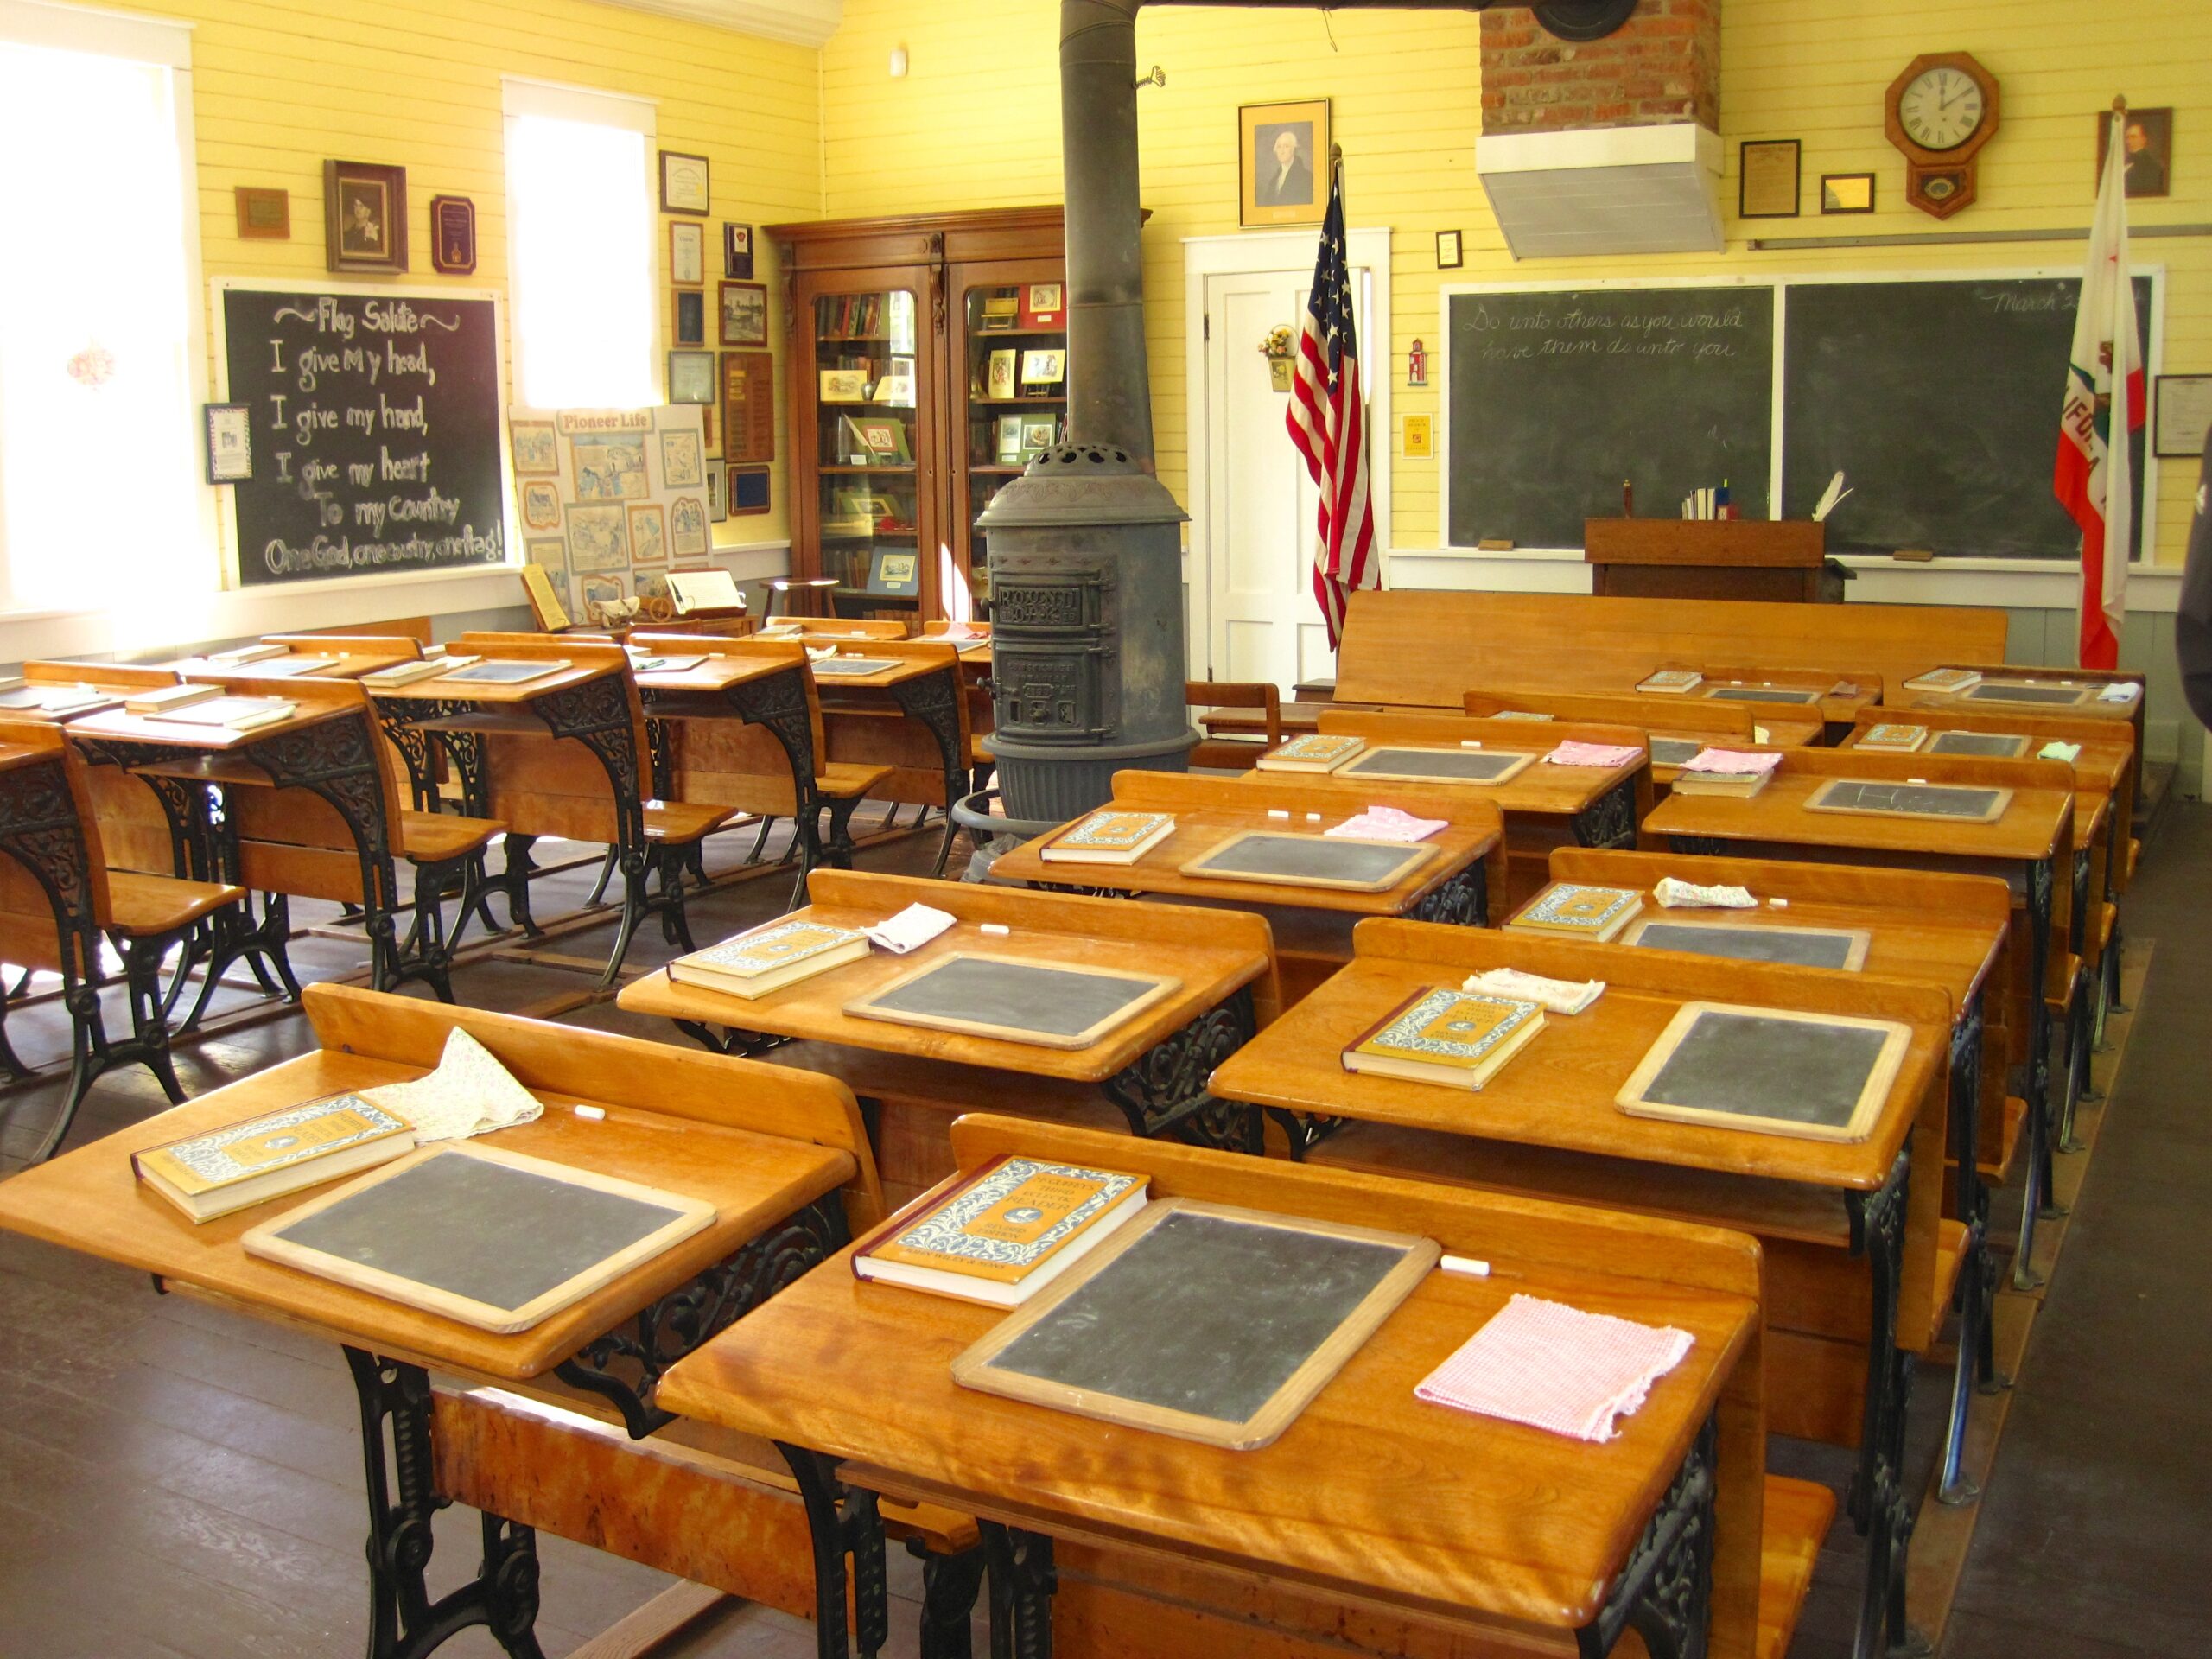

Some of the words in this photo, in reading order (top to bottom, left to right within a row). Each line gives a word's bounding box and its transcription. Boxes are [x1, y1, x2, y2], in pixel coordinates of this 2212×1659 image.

[319, 297, 354, 339] Flag
[362, 301, 418, 333] Salute
[1463, 304, 1500, 331] Do
[1510, 309, 1551, 330] unto
[1557, 308, 1615, 329] others
[1642, 315, 1679, 338] you
[1681, 310, 1743, 329] would
[1981, 291, 2056, 313] March
[270, 339, 287, 372] I
[299, 346, 340, 392] give
[344, 346, 381, 385] My
[388, 339, 435, 386] head,
[1482, 340, 1534, 359] have
[1537, 339, 1601, 356] them
[1607, 336, 1631, 354] do
[1637, 338, 1685, 355] unto
[1693, 342, 1736, 360] you
[270, 394, 287, 429] I
[296, 402, 339, 446] give
[346, 407, 375, 435] my
[380, 393, 428, 435] hand,
[563, 415, 618, 429] Pioneer
[620, 413, 647, 428] Life
[276, 452, 293, 484] I
[298, 459, 340, 500] give
[349, 461, 374, 487] my
[381, 445, 430, 482] heart
[314, 491, 343, 526] To
[355, 501, 385, 538] my
[389, 486, 460, 525] Country
[265, 538, 312, 574] One
[312, 534, 353, 572] God,
[353, 547, 386, 566] one
[435, 537, 463, 557] one
[463, 518, 503, 562] flag!
[1005, 1195, 1071, 1211] READER
